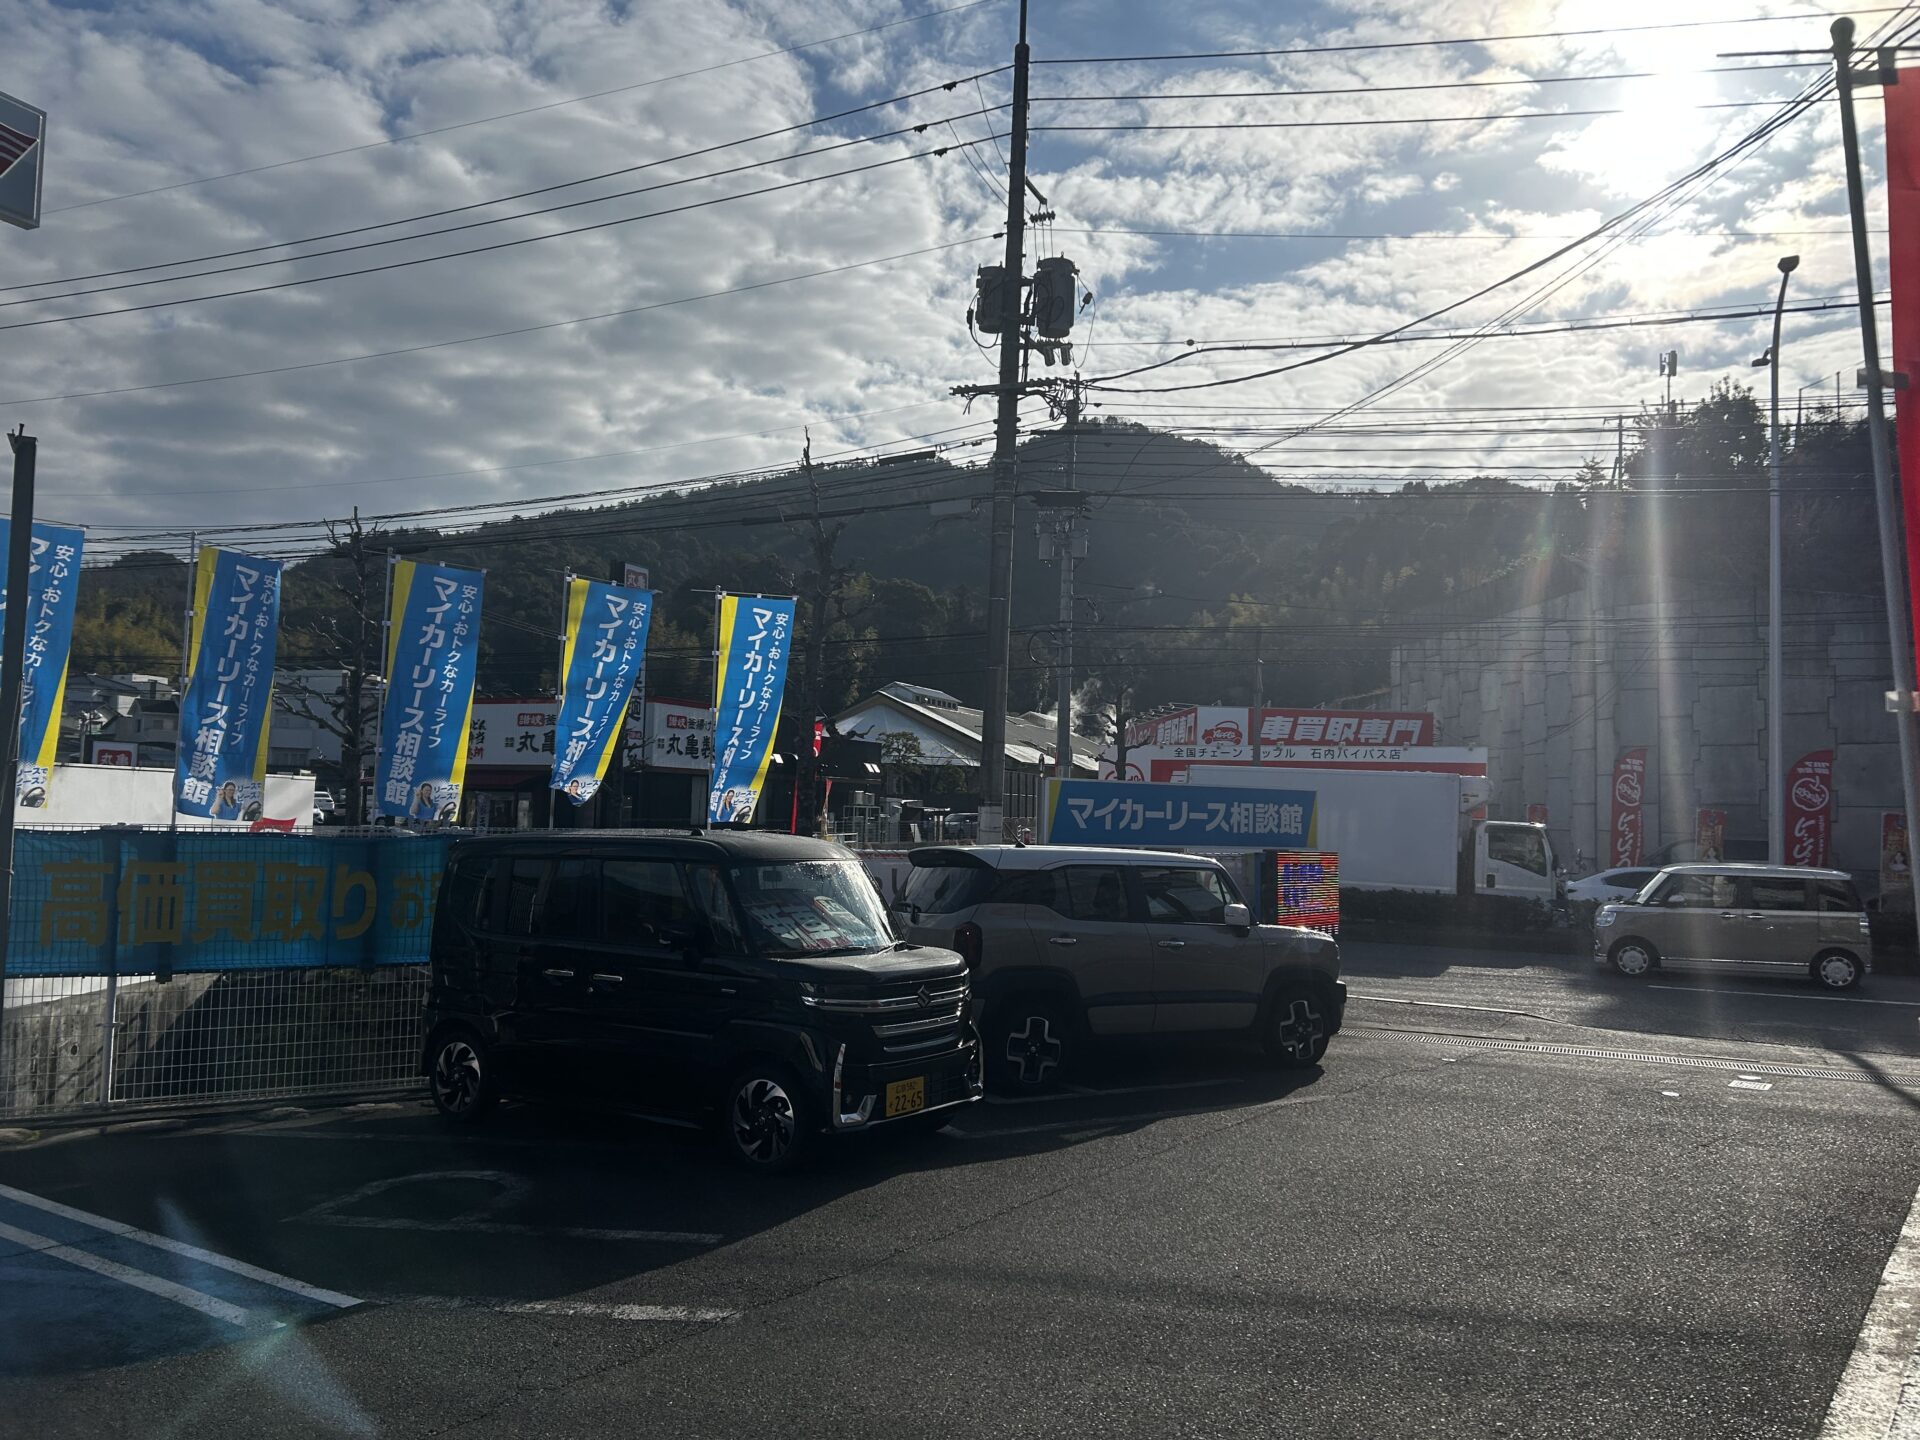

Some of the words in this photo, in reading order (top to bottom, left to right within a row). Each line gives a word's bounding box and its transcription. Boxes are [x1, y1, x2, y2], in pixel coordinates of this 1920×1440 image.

[179, 564, 260, 807] マイカーリース相談館
[229, 574, 277, 746] 安心・おトクなカーライフ
[384, 576, 459, 807] マイカーリース相談館
[427, 584, 479, 749] 安心・おトクなカーライフ
[470, 719, 487, 731] どん
[558, 593, 629, 784] マイカーリース相談
[586, 601, 647, 750] 安心・おトクなカーライフ
[710, 606, 773, 812] マイカーリース相談館
[739, 612, 789, 760] 安心・おトクなカーライフ
[1260, 716, 1423, 745] 車買取専門
[580, 780, 600, 789] リース
[1067, 798, 1303, 835] マイカーリース相談館
[1174, 747, 1243, 758] 全国チェーン
[39, 858, 447, 948] 高価買取りお
[895, 1090, 923, 1113] 22-65
